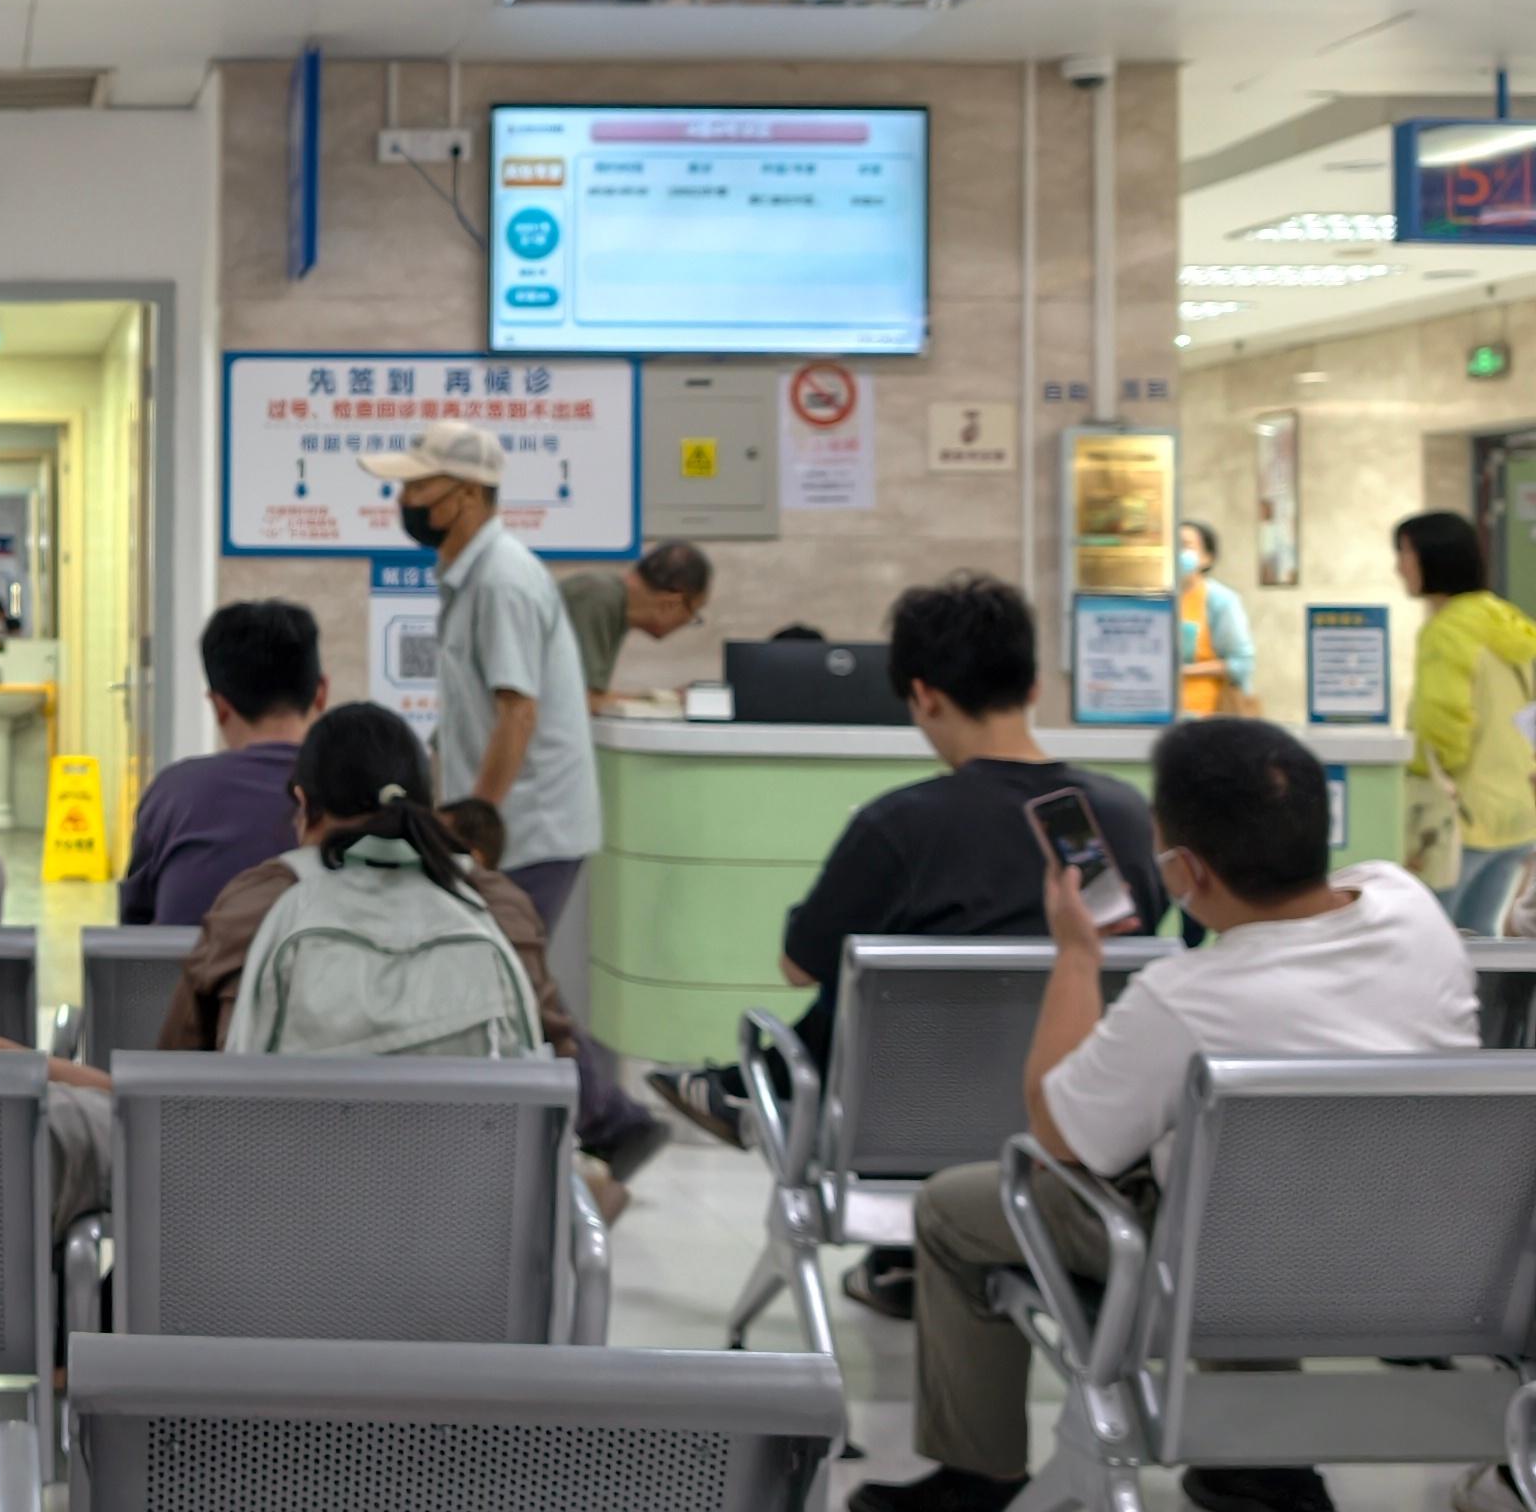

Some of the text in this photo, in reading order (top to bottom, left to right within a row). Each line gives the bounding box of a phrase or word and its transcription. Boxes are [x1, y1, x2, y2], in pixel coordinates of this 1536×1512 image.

[309, 366, 552, 395] 先签到 再候诊
